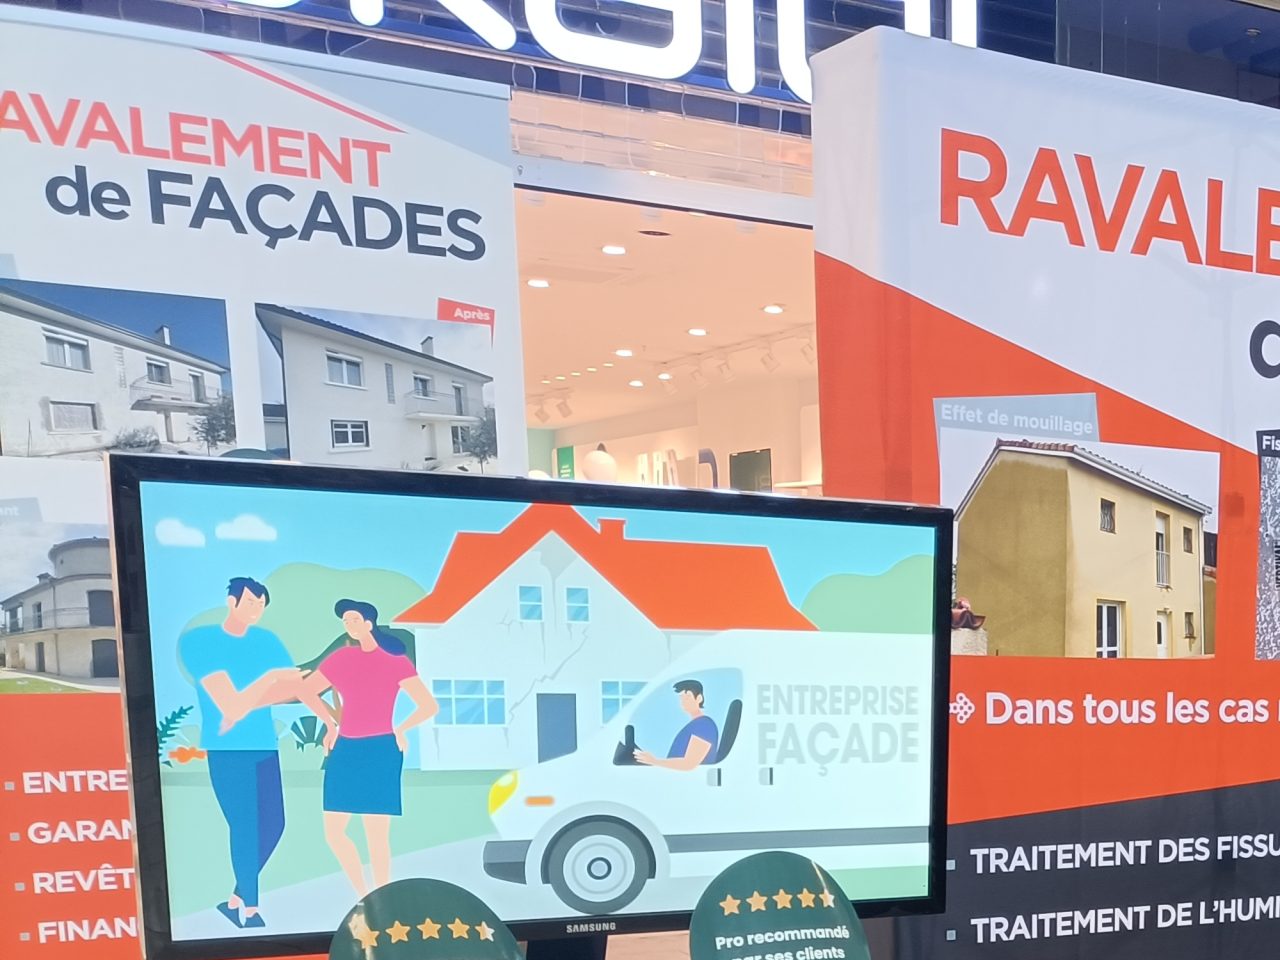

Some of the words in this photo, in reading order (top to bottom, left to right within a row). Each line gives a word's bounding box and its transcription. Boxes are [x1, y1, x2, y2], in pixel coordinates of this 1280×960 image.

[45, 165, 131, 219] de
[147, 169, 486, 261] FAÇADES
[454, 308, 490, 321] Après
[941, 404, 983, 423] Effet
[987, 409, 1008, 426] de
[1014, 415, 1093, 435] mouillage
[756, 684, 919, 715] ENTREPRISE
[986, 691, 1074, 725] Dans
[1083, 693, 1156, 724] tous
[1166, 692, 1209, 724] les
[1218, 696, 1269, 723] cas
[758, 722, 919, 776] FAÇADE
[22, 770, 128, 794] ENTRE
[970, 840, 1152, 874] TRAITEMENT
[1158, 837, 1211, 863] DES
[566, 922, 617, 933] SAMSUNG
[715, 934, 744, 950] Pro
[747, 924, 850, 945] recommandé
[970, 904, 1151, 944] TRAITEMENT
[1156, 902, 1193, 929] DE
